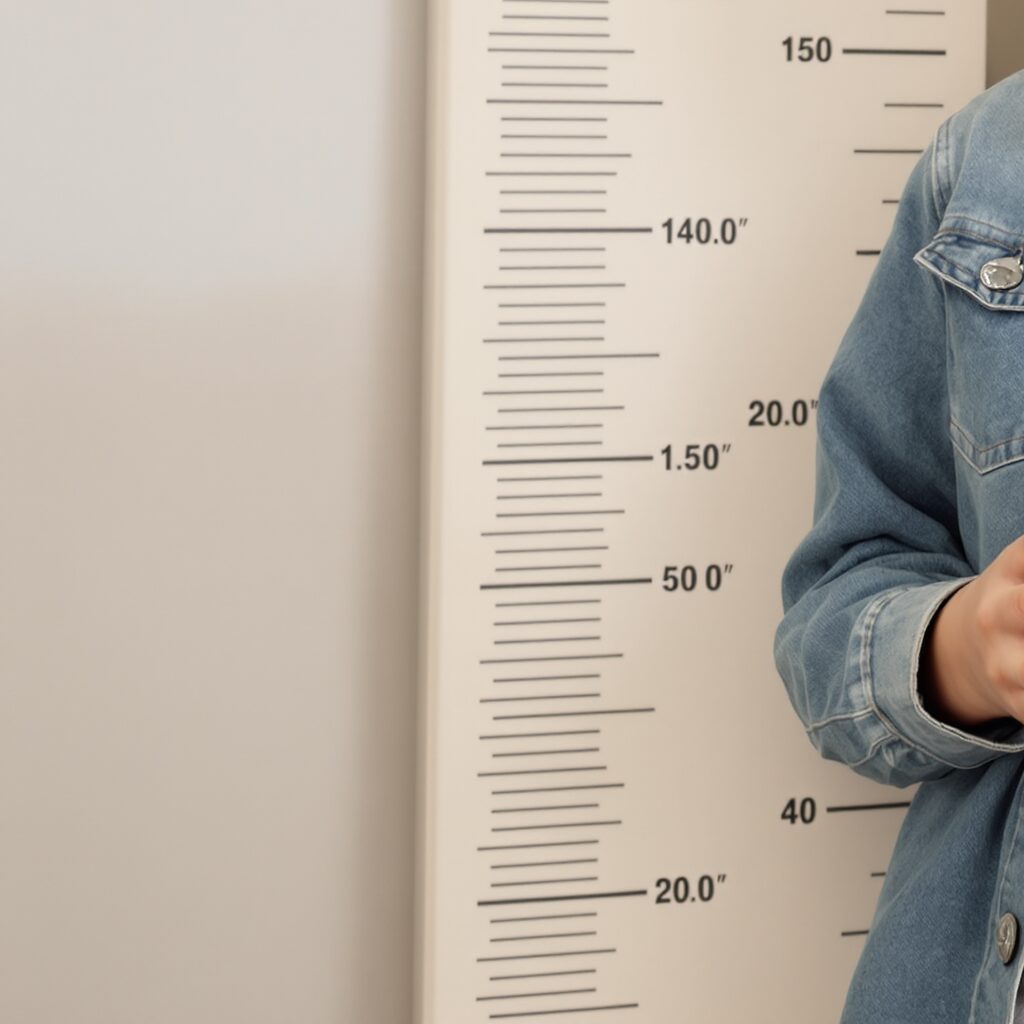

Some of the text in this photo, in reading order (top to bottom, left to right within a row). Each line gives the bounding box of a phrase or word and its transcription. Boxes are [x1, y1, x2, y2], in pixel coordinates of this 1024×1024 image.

[781, 36, 833, 63] 150
[661, 217, 749, 245] 140.0"
[660, 443, 732, 471] 1.50"
[780, 797, 817, 824] 40
[654, 874, 727, 904] 20.0"
